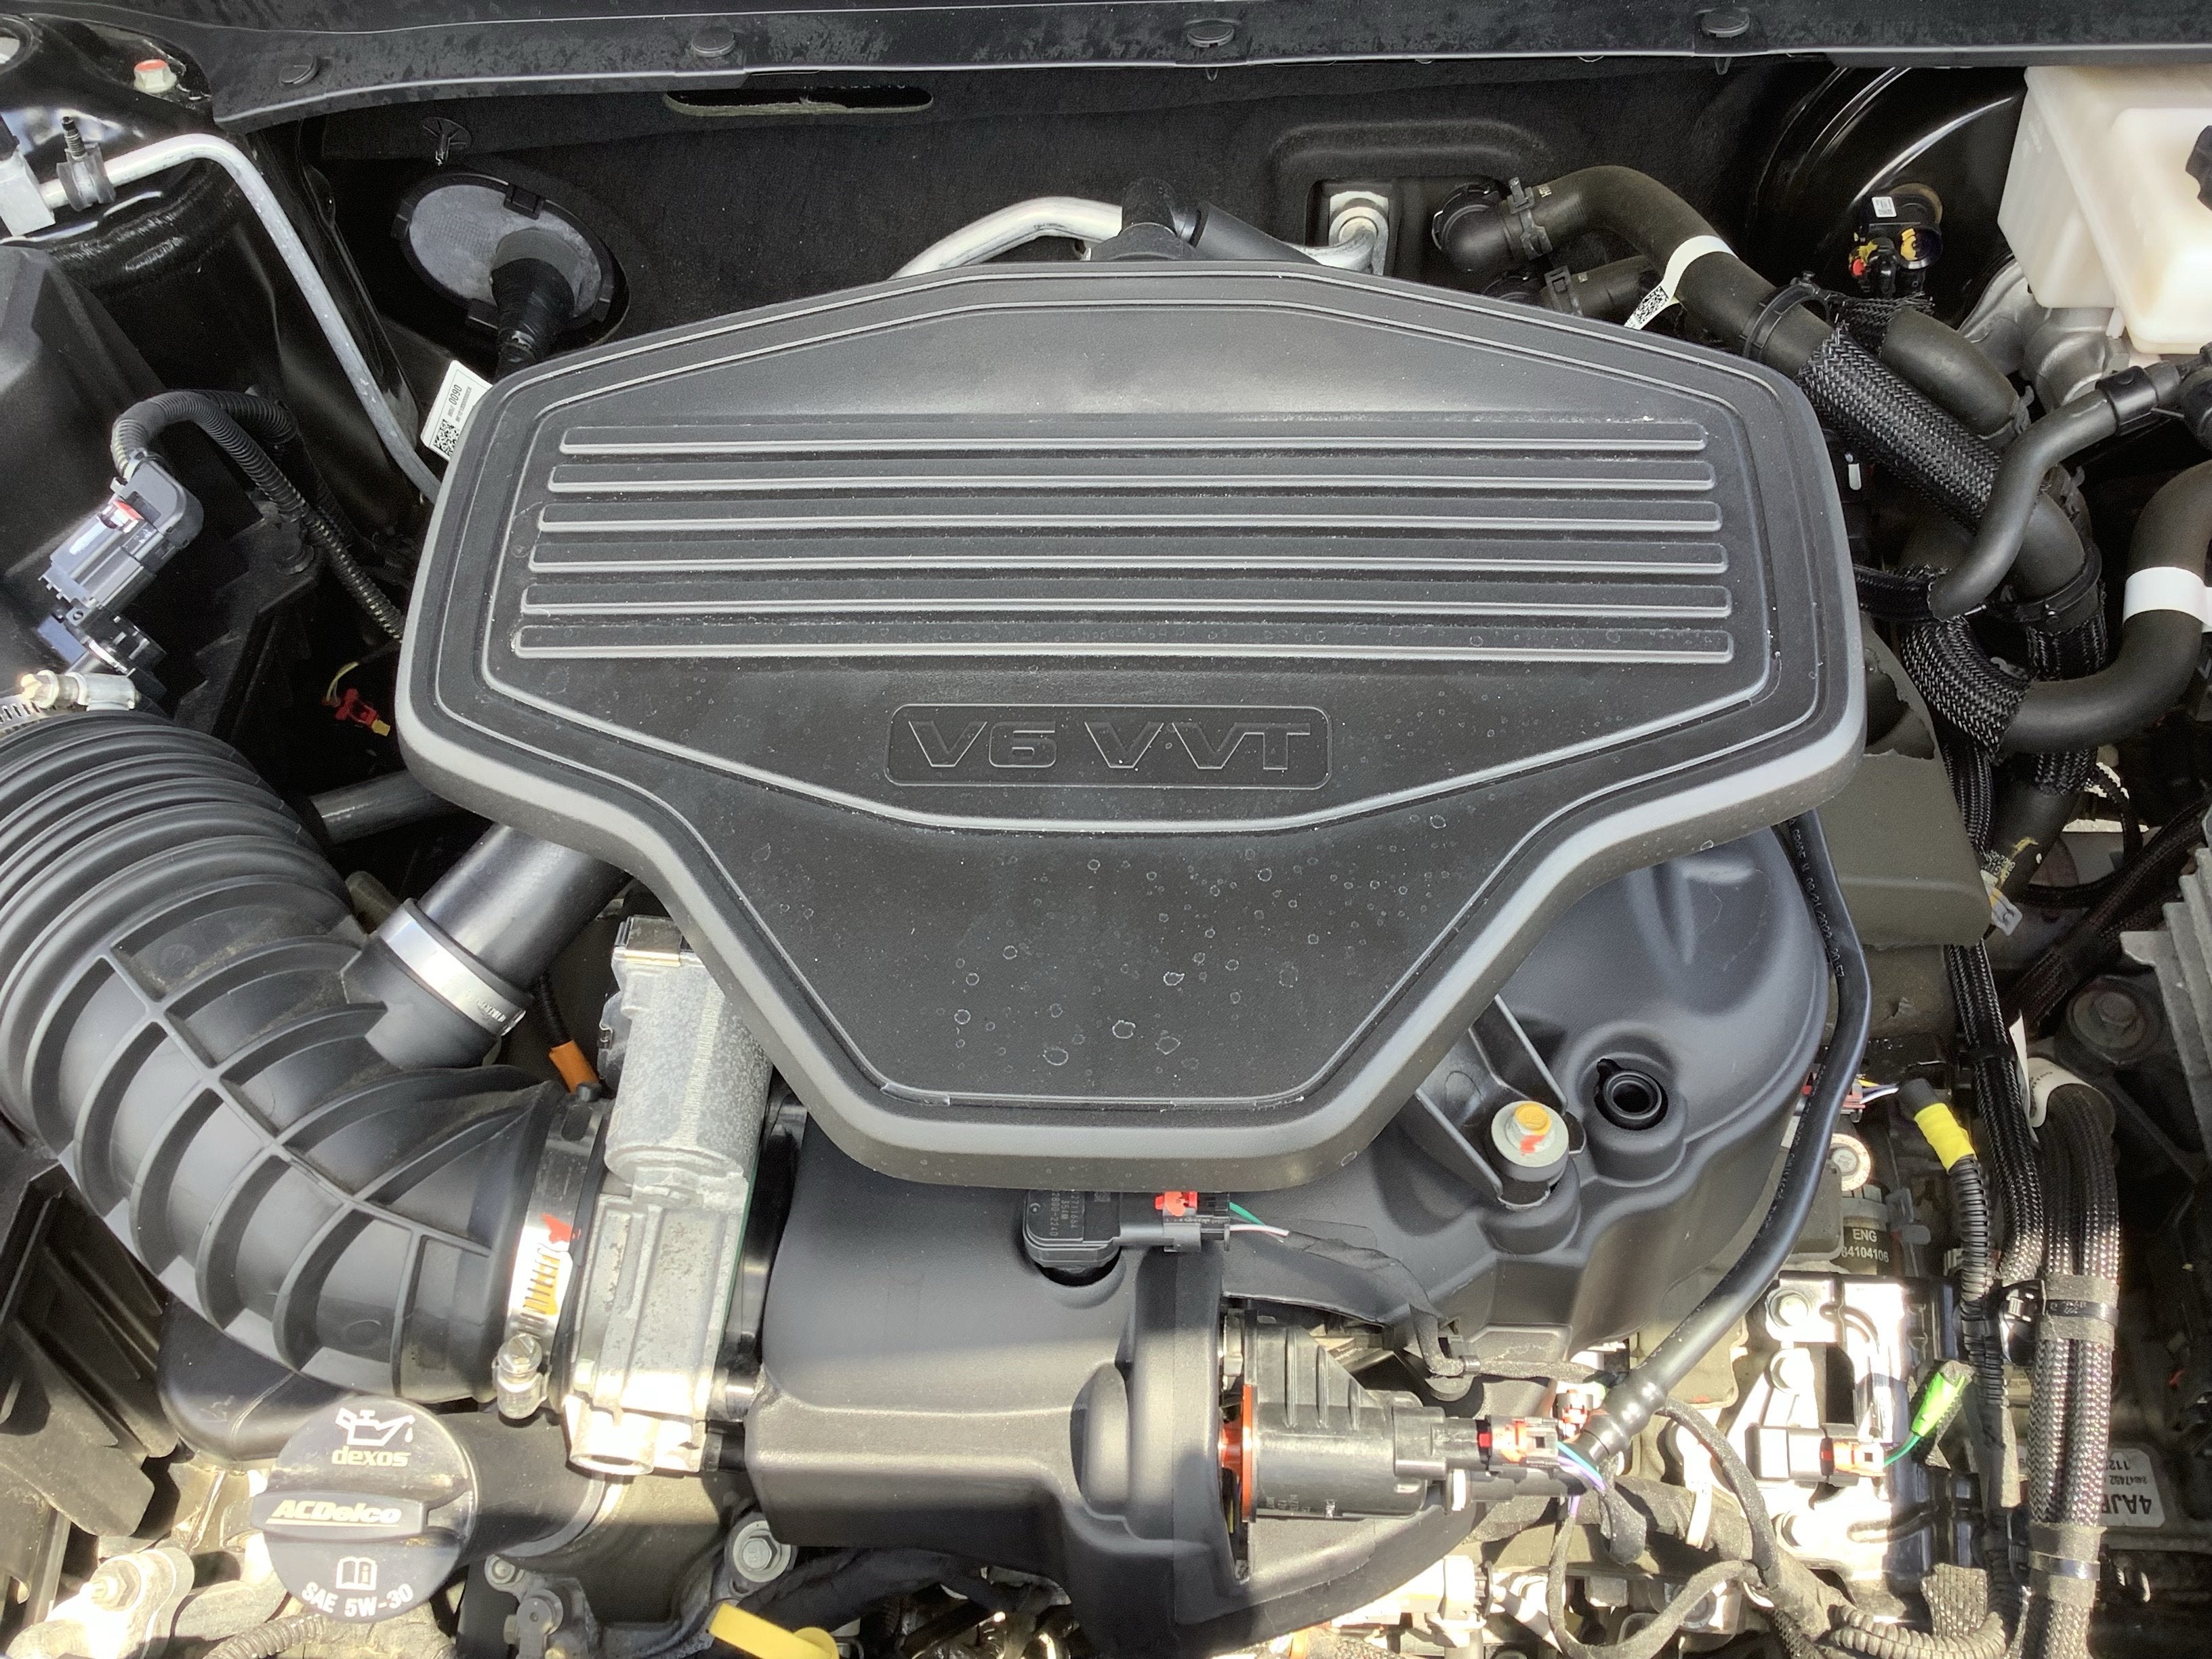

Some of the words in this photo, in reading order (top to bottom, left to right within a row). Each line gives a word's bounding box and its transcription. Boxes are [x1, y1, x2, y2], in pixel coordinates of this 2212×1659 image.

[448, 384, 463, 405] 0090
[908, 720, 1057, 768] V6
[1084, 720, 1311, 771] VVT
[1852, 1228, 1877, 1242] ENG
[331, 1446, 411, 1467] dexos
[271, 1499, 402, 1524] ACDelco
[302, 1582, 339, 1614] SAE
[344, 1583, 414, 1618] 5W-30
